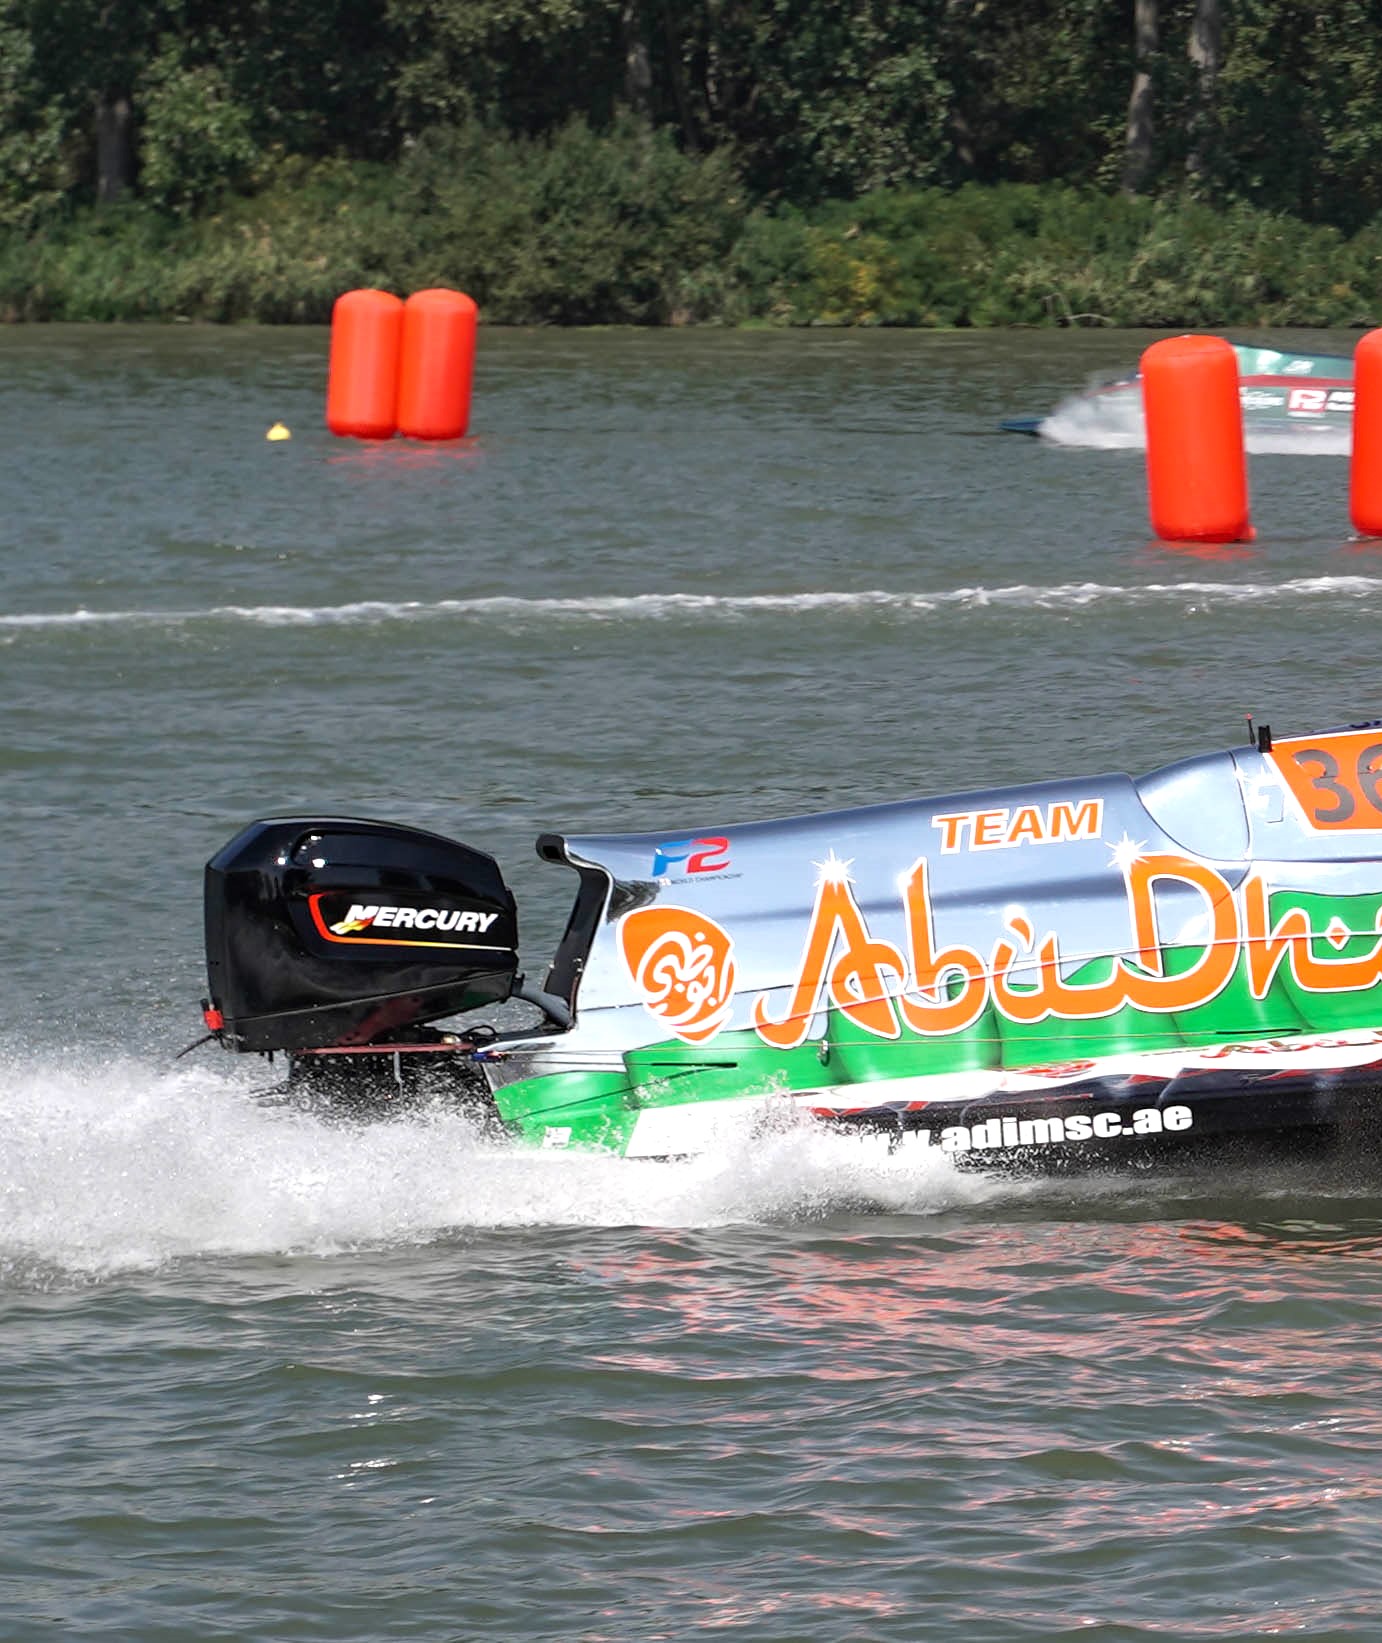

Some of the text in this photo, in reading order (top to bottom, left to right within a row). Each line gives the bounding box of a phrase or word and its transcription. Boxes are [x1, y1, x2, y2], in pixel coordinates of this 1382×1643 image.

[932, 799, 1103, 854] TEAM
[652, 836, 731, 877] F2
[330, 904, 499, 934] MERCURY
[749, 856, 1122, 1050] Abu
